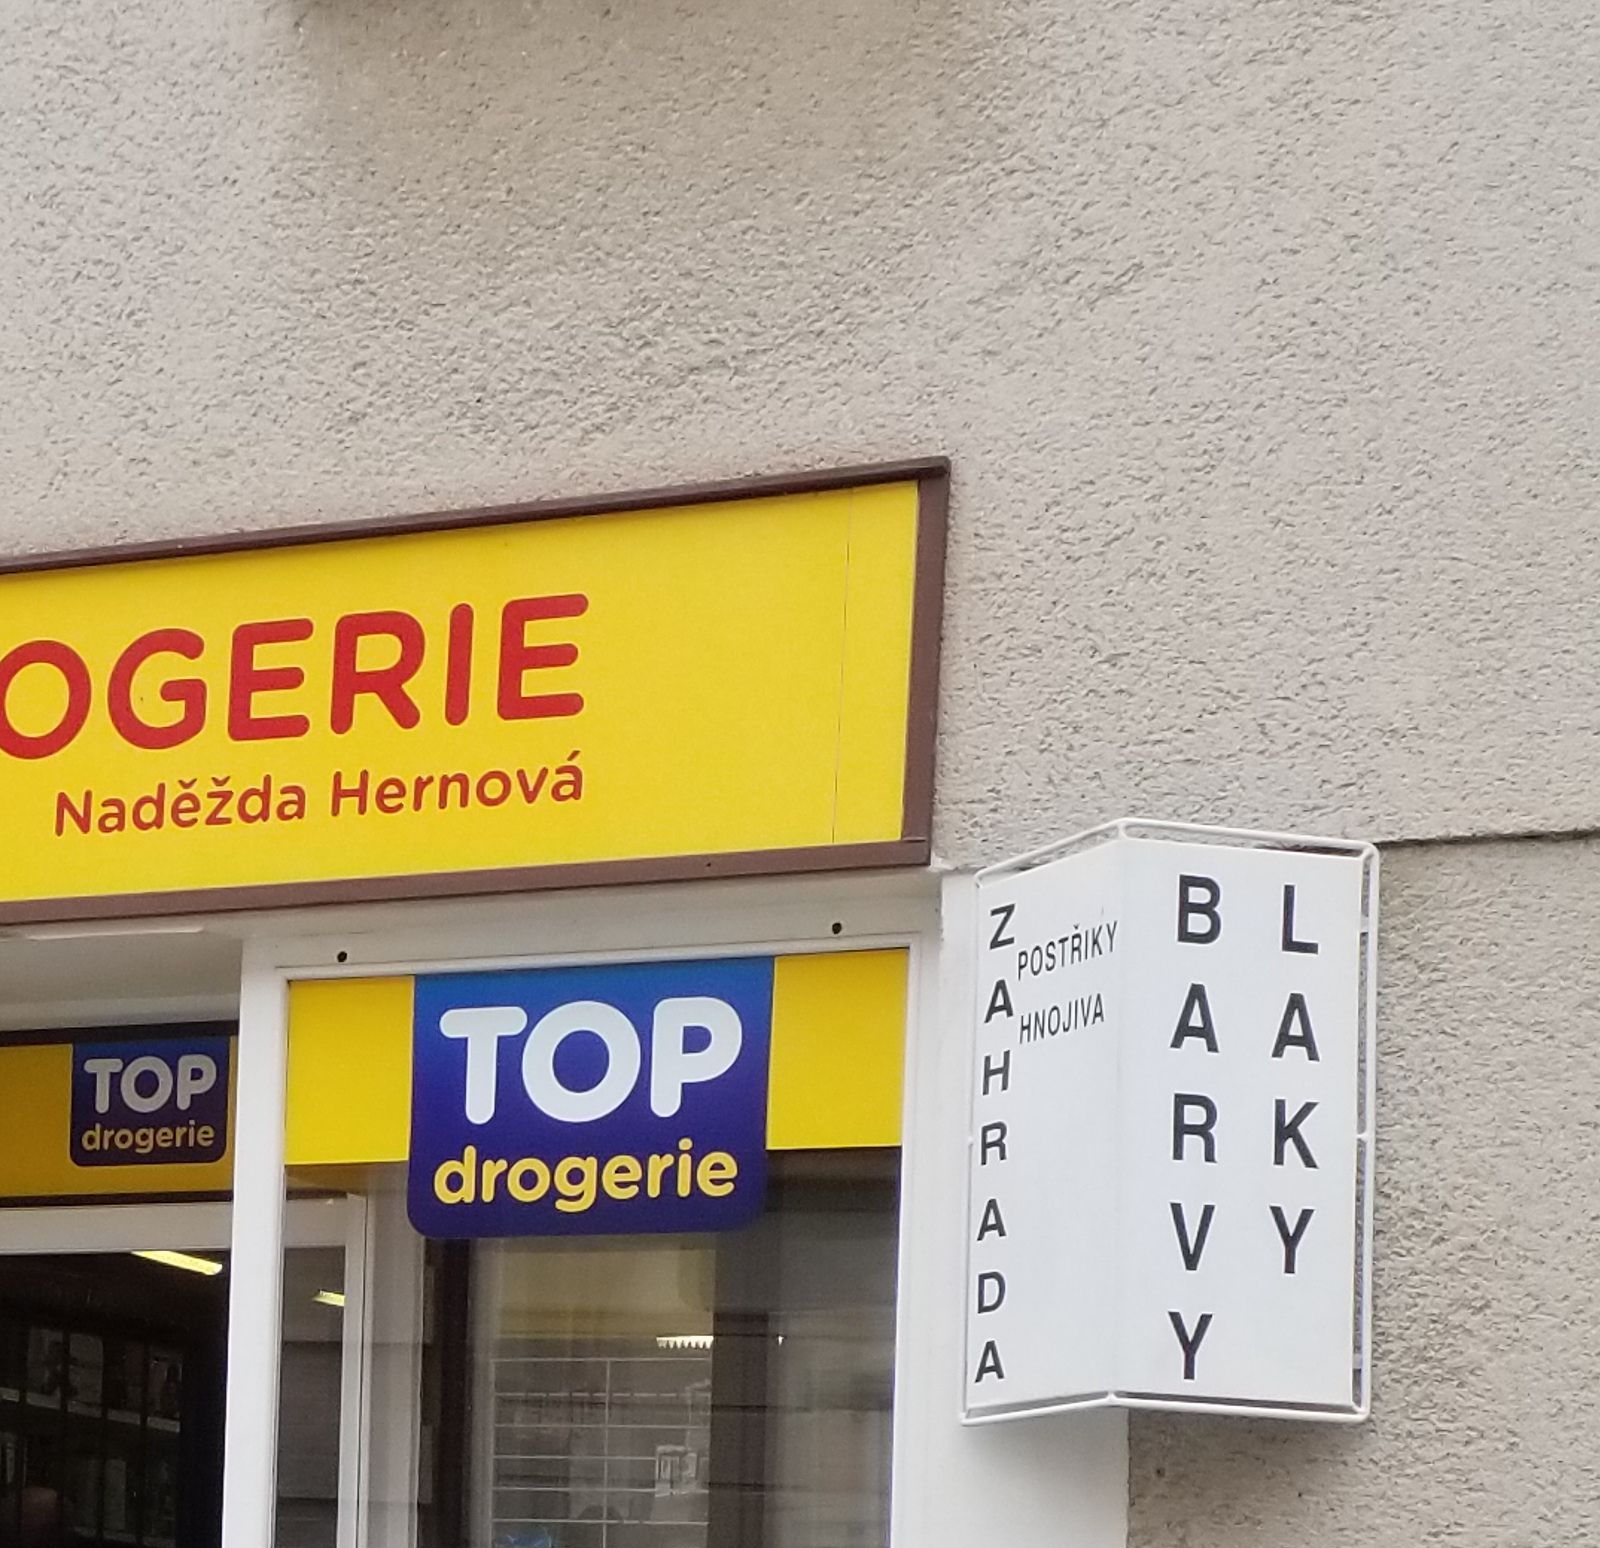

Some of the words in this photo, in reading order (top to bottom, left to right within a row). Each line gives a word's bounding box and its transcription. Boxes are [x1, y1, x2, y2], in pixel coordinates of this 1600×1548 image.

[55, 777, 306, 837] Naděžda
[331, 751, 585, 817] Hernová
[1017, 920, 1118, 981] POSTŘIKY
[1019, 993, 1105, 1045] HNOJIVA
[84, 1054, 217, 1114] TOP
[440, 996, 743, 1125] TOP
[1270, 884, 1320, 1274] LAKY
[82, 1120, 214, 1153] drogerie
[975, 903, 1016, 1383] ZAHRADA
[1168, 874, 1222, 1381] BARVY
[434, 1139, 737, 1212] drogerie
